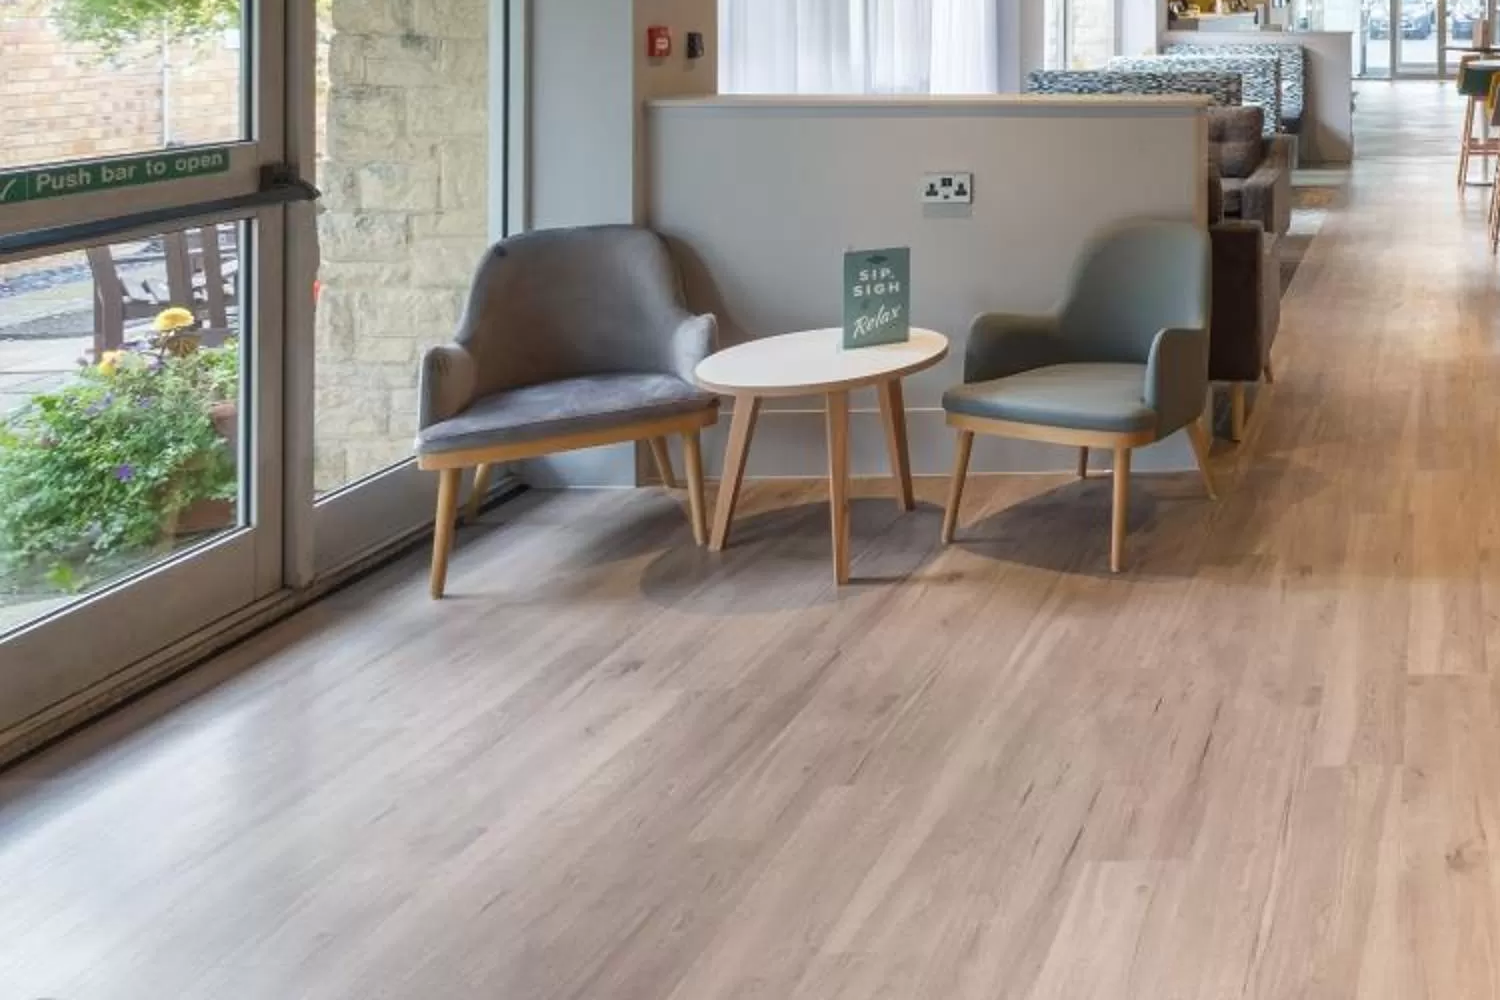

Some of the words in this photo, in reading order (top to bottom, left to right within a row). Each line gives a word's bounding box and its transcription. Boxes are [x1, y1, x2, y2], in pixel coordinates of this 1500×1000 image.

[36, 166, 91, 193] Push
[101, 164, 137, 183] bar
[145, 159, 166, 176] to
[175, 152, 224, 173] open
[853, 282, 900, 297] SIGH
[853, 303, 901, 339] Relax
